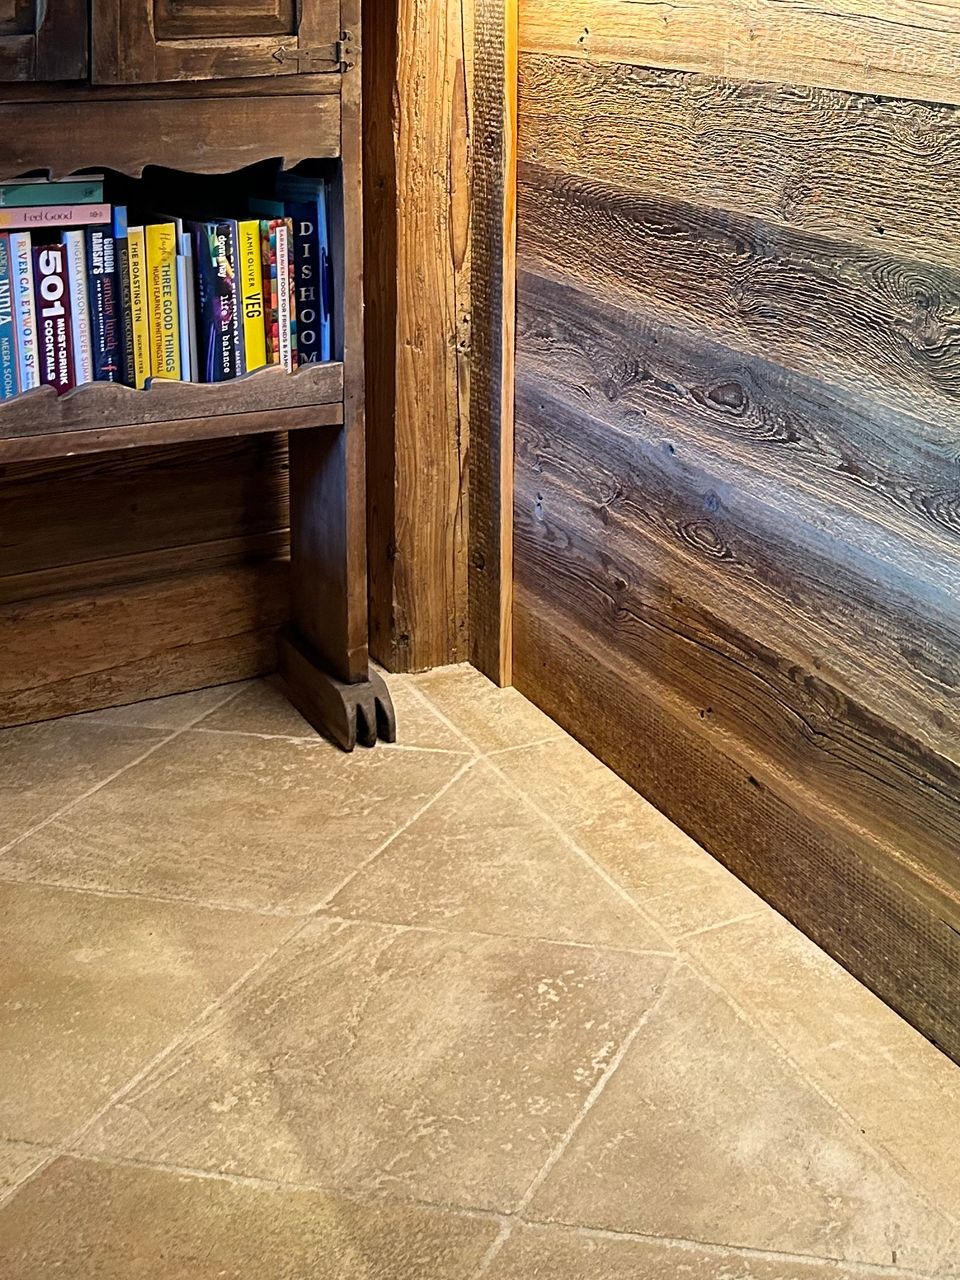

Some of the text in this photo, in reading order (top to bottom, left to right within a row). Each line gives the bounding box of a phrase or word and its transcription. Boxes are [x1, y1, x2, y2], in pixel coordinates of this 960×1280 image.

[23, 210, 72, 222] Feel Good
[92, 231, 104, 275] RAMSAY'S
[103, 237, 115, 274] GORDON
[246, 232, 255, 288] JAMIE OLIVER
[0, 279, 13, 326] INDIA
[39, 250, 66, 318] 501
[131, 241, 142, 322] THE ROASTING TIN
[245, 292, 262, 319] VEG
[299, 222, 317, 363] DISHOOM
[22, 308, 33, 337] TWO
[74, 240, 90, 382] NIGELLA LAWSON FOREVER SUMM
[103, 277, 118, 351] sunday lunch
[124, 310, 133, 355] CHOCOLATE
[161, 263, 176, 373] THREE GOOD THINGS
[220, 295, 232, 373] life in balance
[1, 337, 11, 368] MEERA
[24, 339, 35, 369] EASY
[44, 319, 56, 381] COCKTAILS
[57, 317, 69, 385] MUST-DRINK
